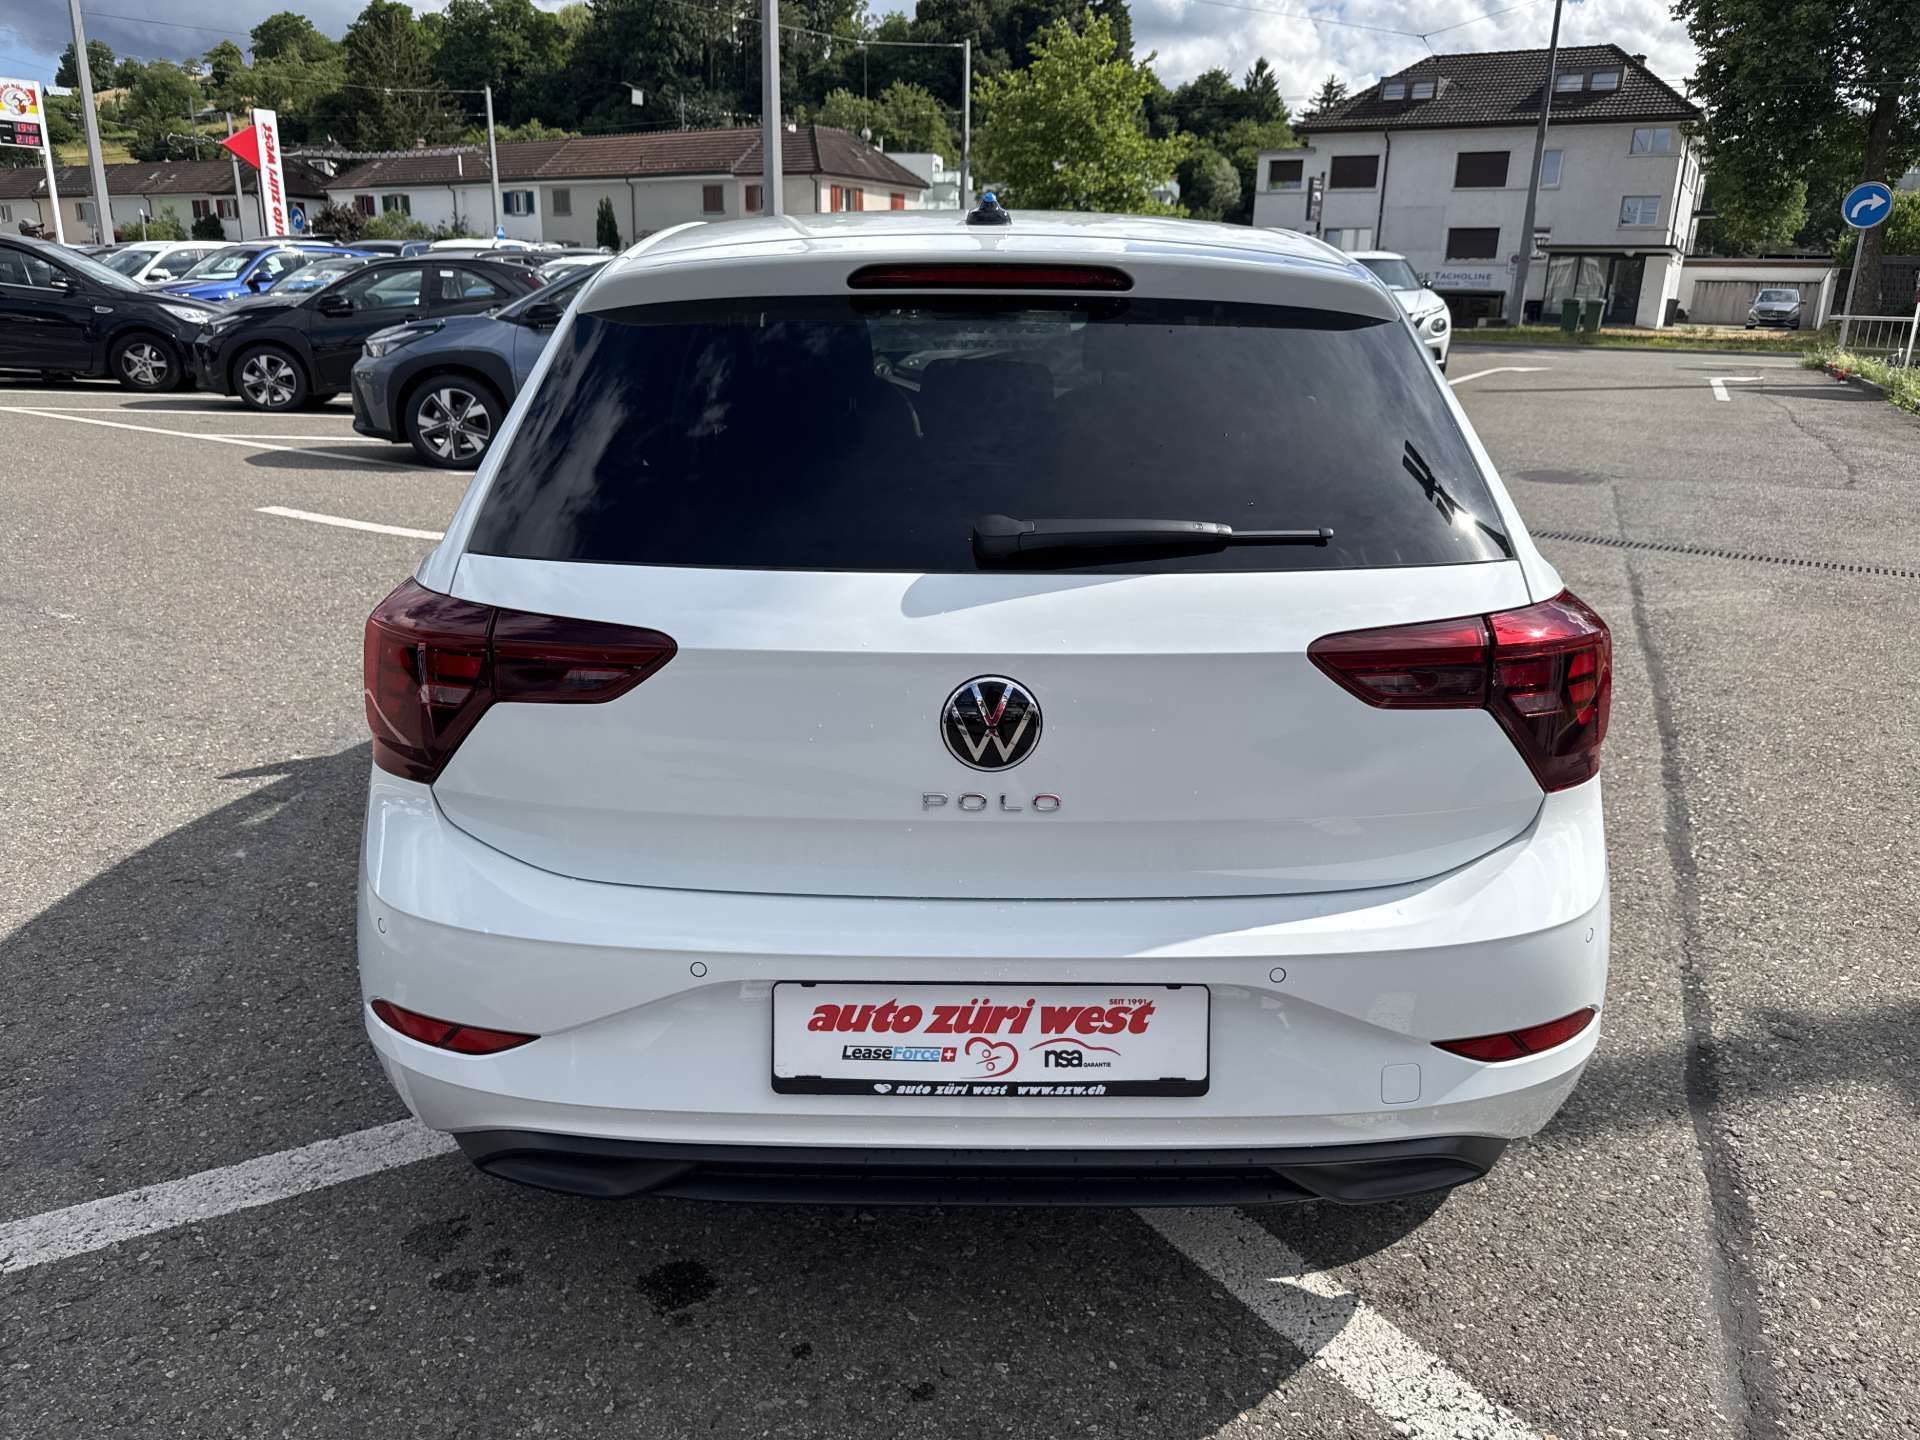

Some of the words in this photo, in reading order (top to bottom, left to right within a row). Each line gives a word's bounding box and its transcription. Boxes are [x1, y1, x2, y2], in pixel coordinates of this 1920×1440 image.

[272, 206, 285, 236] uto
[1433, 271, 1493, 281] TACHOLINE
[922, 792, 1061, 812] POLO
[1109, 998, 1125, 1006] SEIT
[1127, 998, 1147, 1006] 1991
[807, 998, 923, 1033] auto
[923, 998, 1036, 1034] züri
[1040, 999, 1156, 1035] west
[842, 1045, 940, 1061] LeaseForce
[1044, 1049, 1083, 1068] nsa
[896, 1084, 931, 1095] auto
[934, 1083, 969, 1095] züri
[972, 1084, 1008, 1095] west
[1017, 1084, 1107, 1096] www.azw.ch
